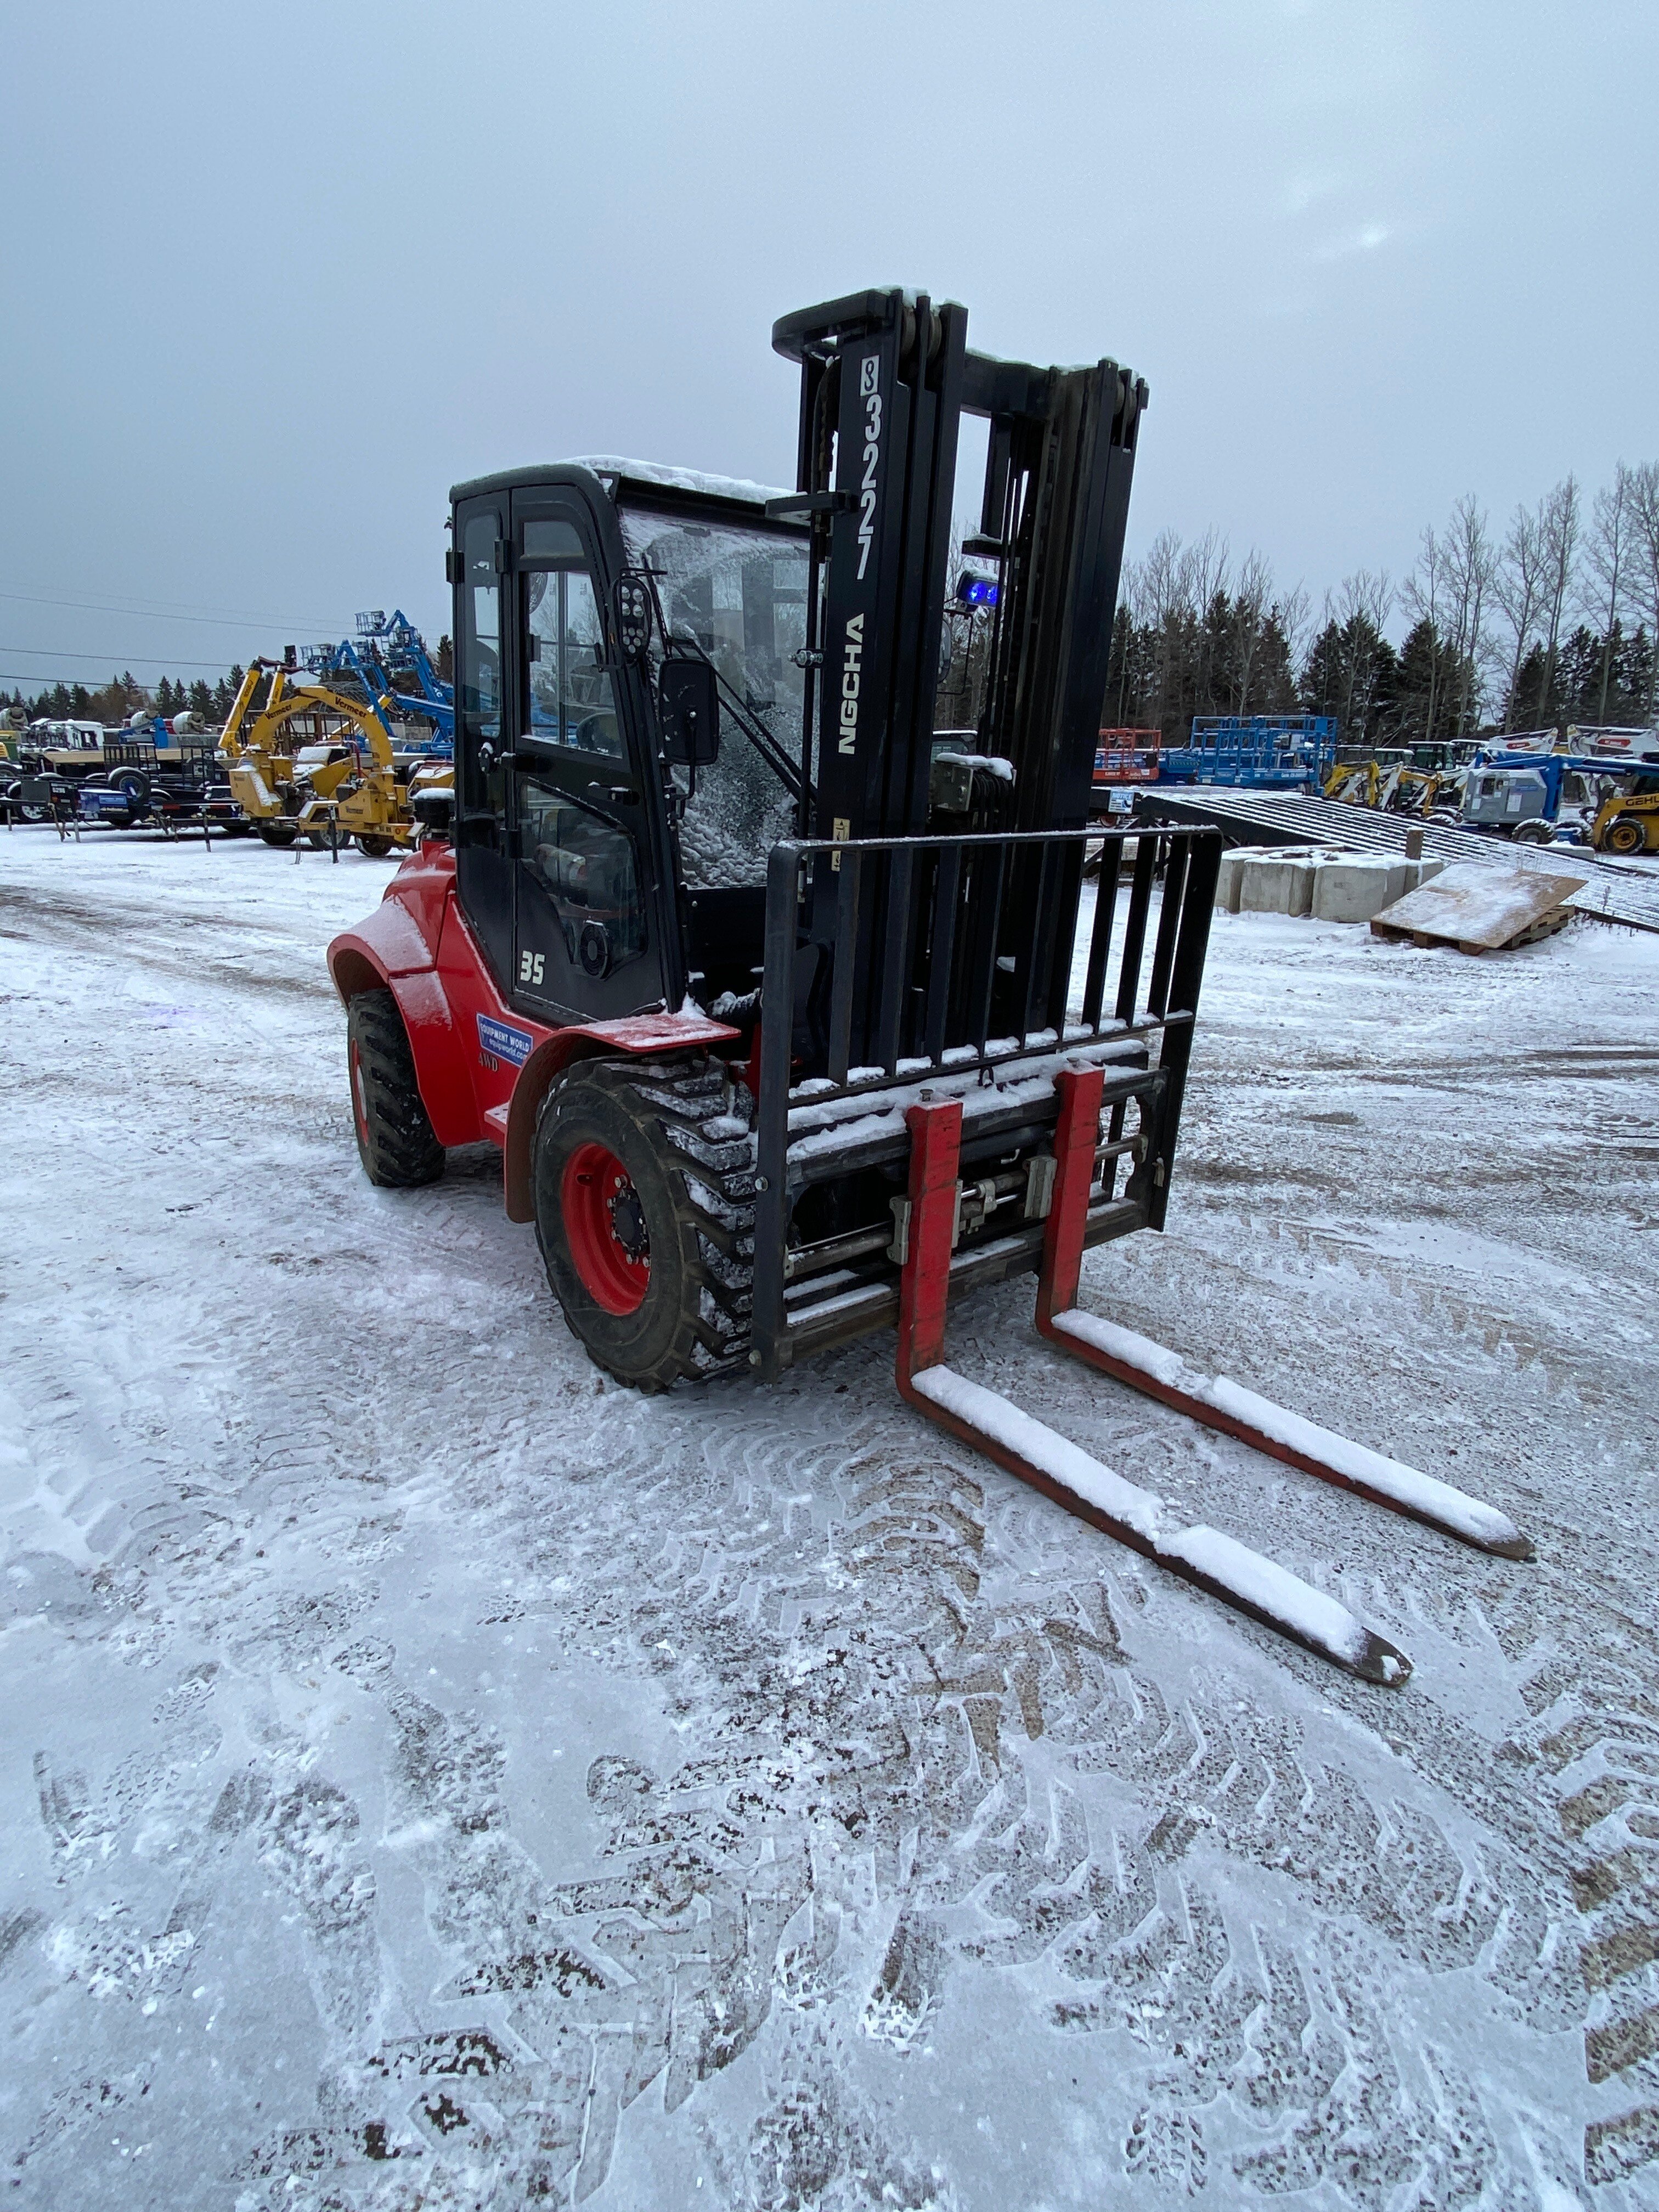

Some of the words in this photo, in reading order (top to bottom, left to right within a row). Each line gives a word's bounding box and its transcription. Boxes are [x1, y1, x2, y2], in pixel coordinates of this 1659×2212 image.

[838, 613, 864, 754] NGCHA
[264, 704, 292, 720] Vermeer
[335, 697, 366, 718] Vermeer
[1626, 795, 1659, 806] GEHL
[520, 950, 545, 985] 35
[480, 1023, 508, 1043] EQUIPMENT
[510, 1035, 529, 1053] WORLD
[478, 1052, 498, 1072] 4WD
